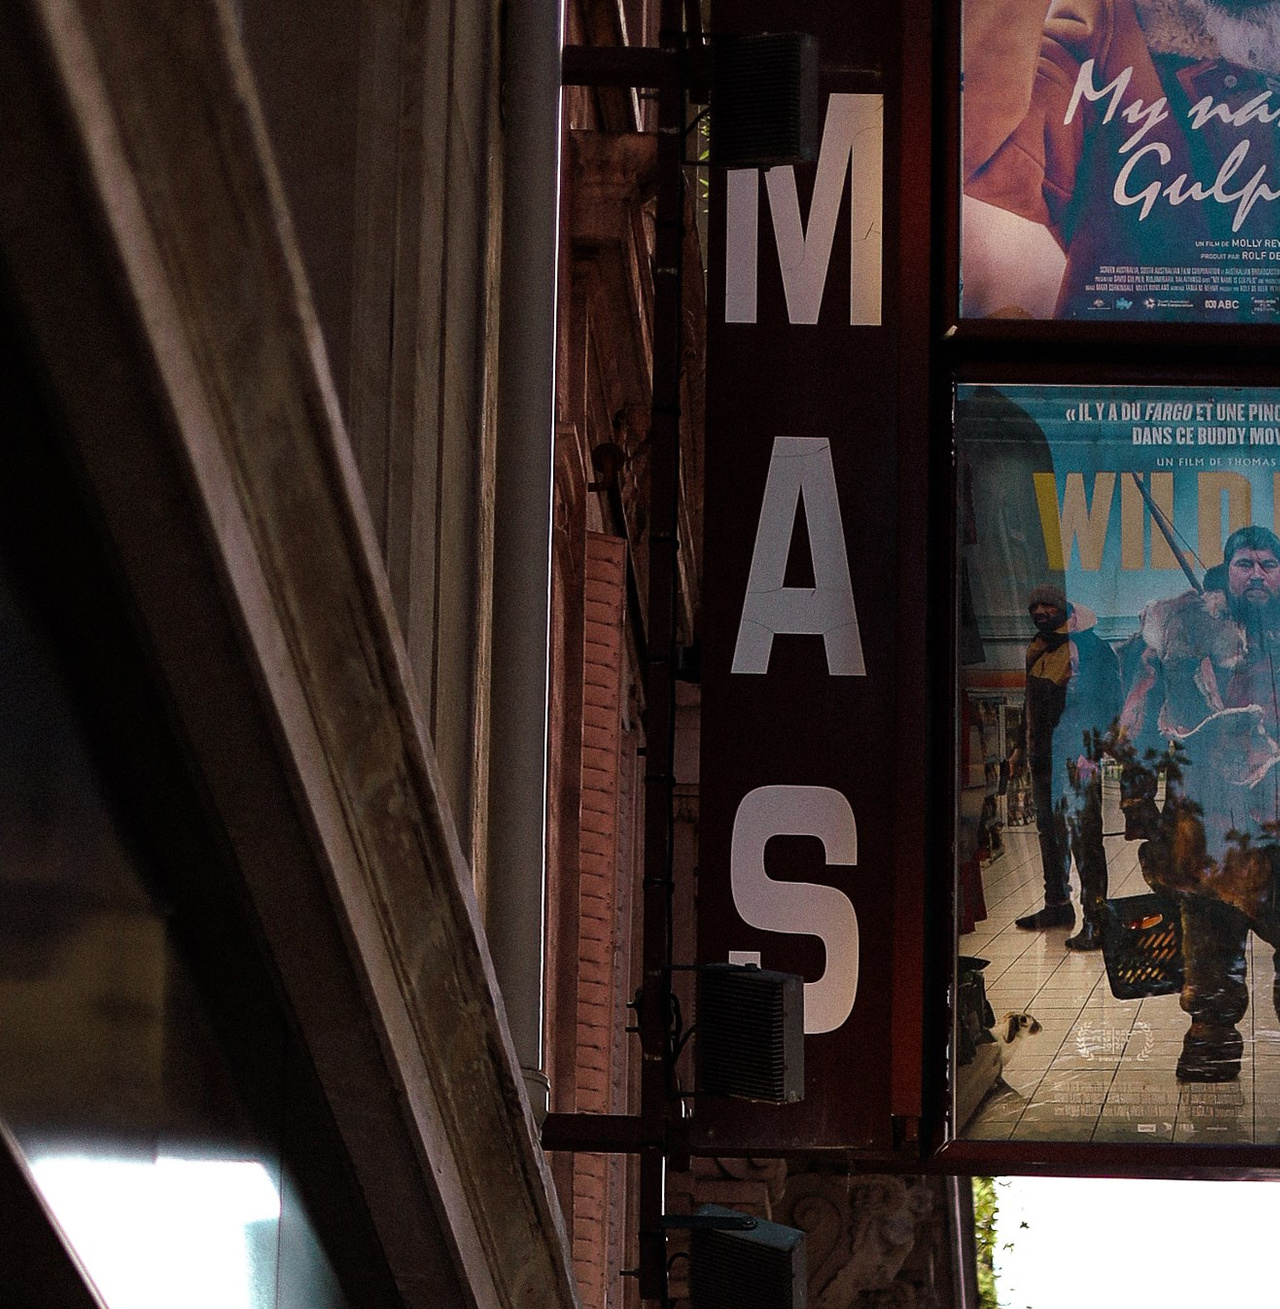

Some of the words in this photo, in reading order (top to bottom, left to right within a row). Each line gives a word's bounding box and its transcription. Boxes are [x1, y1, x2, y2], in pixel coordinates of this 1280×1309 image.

[1063, 58, 1169, 154] My
[1231, 239, 1262, 248] MOLLY
[1241, 252, 1267, 260] ROLF
[1217, 300, 1240, 309] ABC
[1095, 402, 1105, 421] Y
[1108, 402, 1118, 421] A
[1121, 402, 1141, 421] DU
[1145, 403, 1193, 421] FARGO
[1196, 403, 1214, 421] ET
[1216, 403, 1246, 421] UNE
[1132, 427, 1173, 446] DANS
[1176, 427, 1195, 445] CE
[1197, 427, 1246, 446] BUDDY
[1156, 457, 1174, 467] UN
[1178, 457, 1204, 467] FILM
[1209, 457, 1222, 467] DE
[1228, 457, 1277, 468] THOMAS
[1032, 471, 1253, 572] WILD
